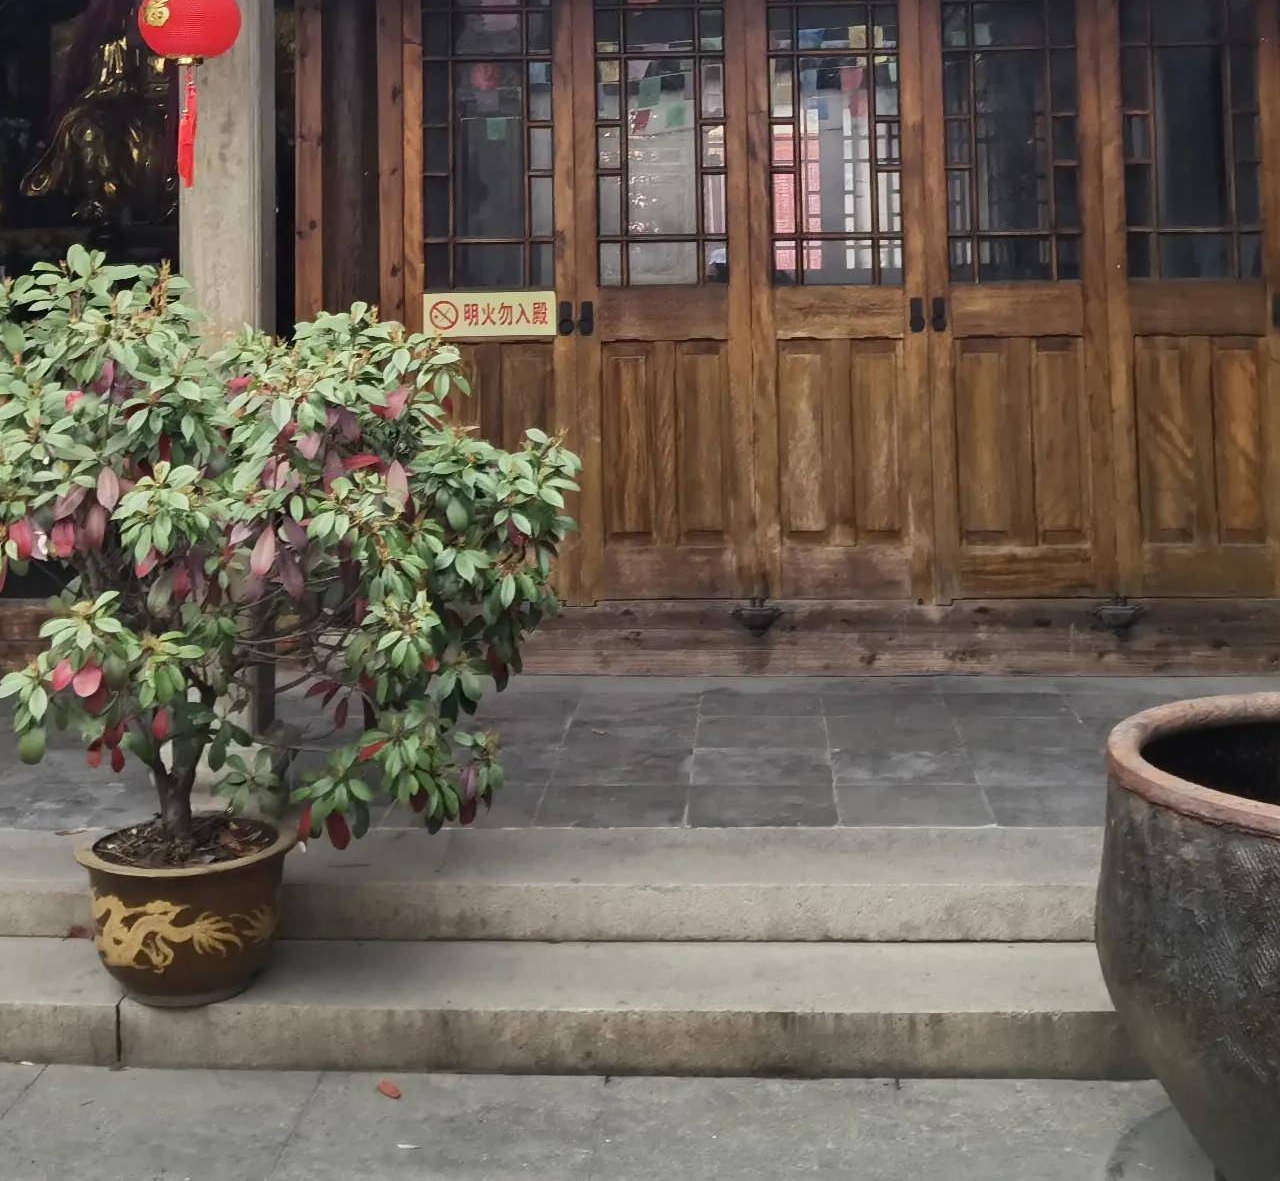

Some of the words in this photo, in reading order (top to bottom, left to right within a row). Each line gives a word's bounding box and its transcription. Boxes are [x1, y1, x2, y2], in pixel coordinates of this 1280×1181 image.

[463, 301, 549, 327] 明火勿入殿
